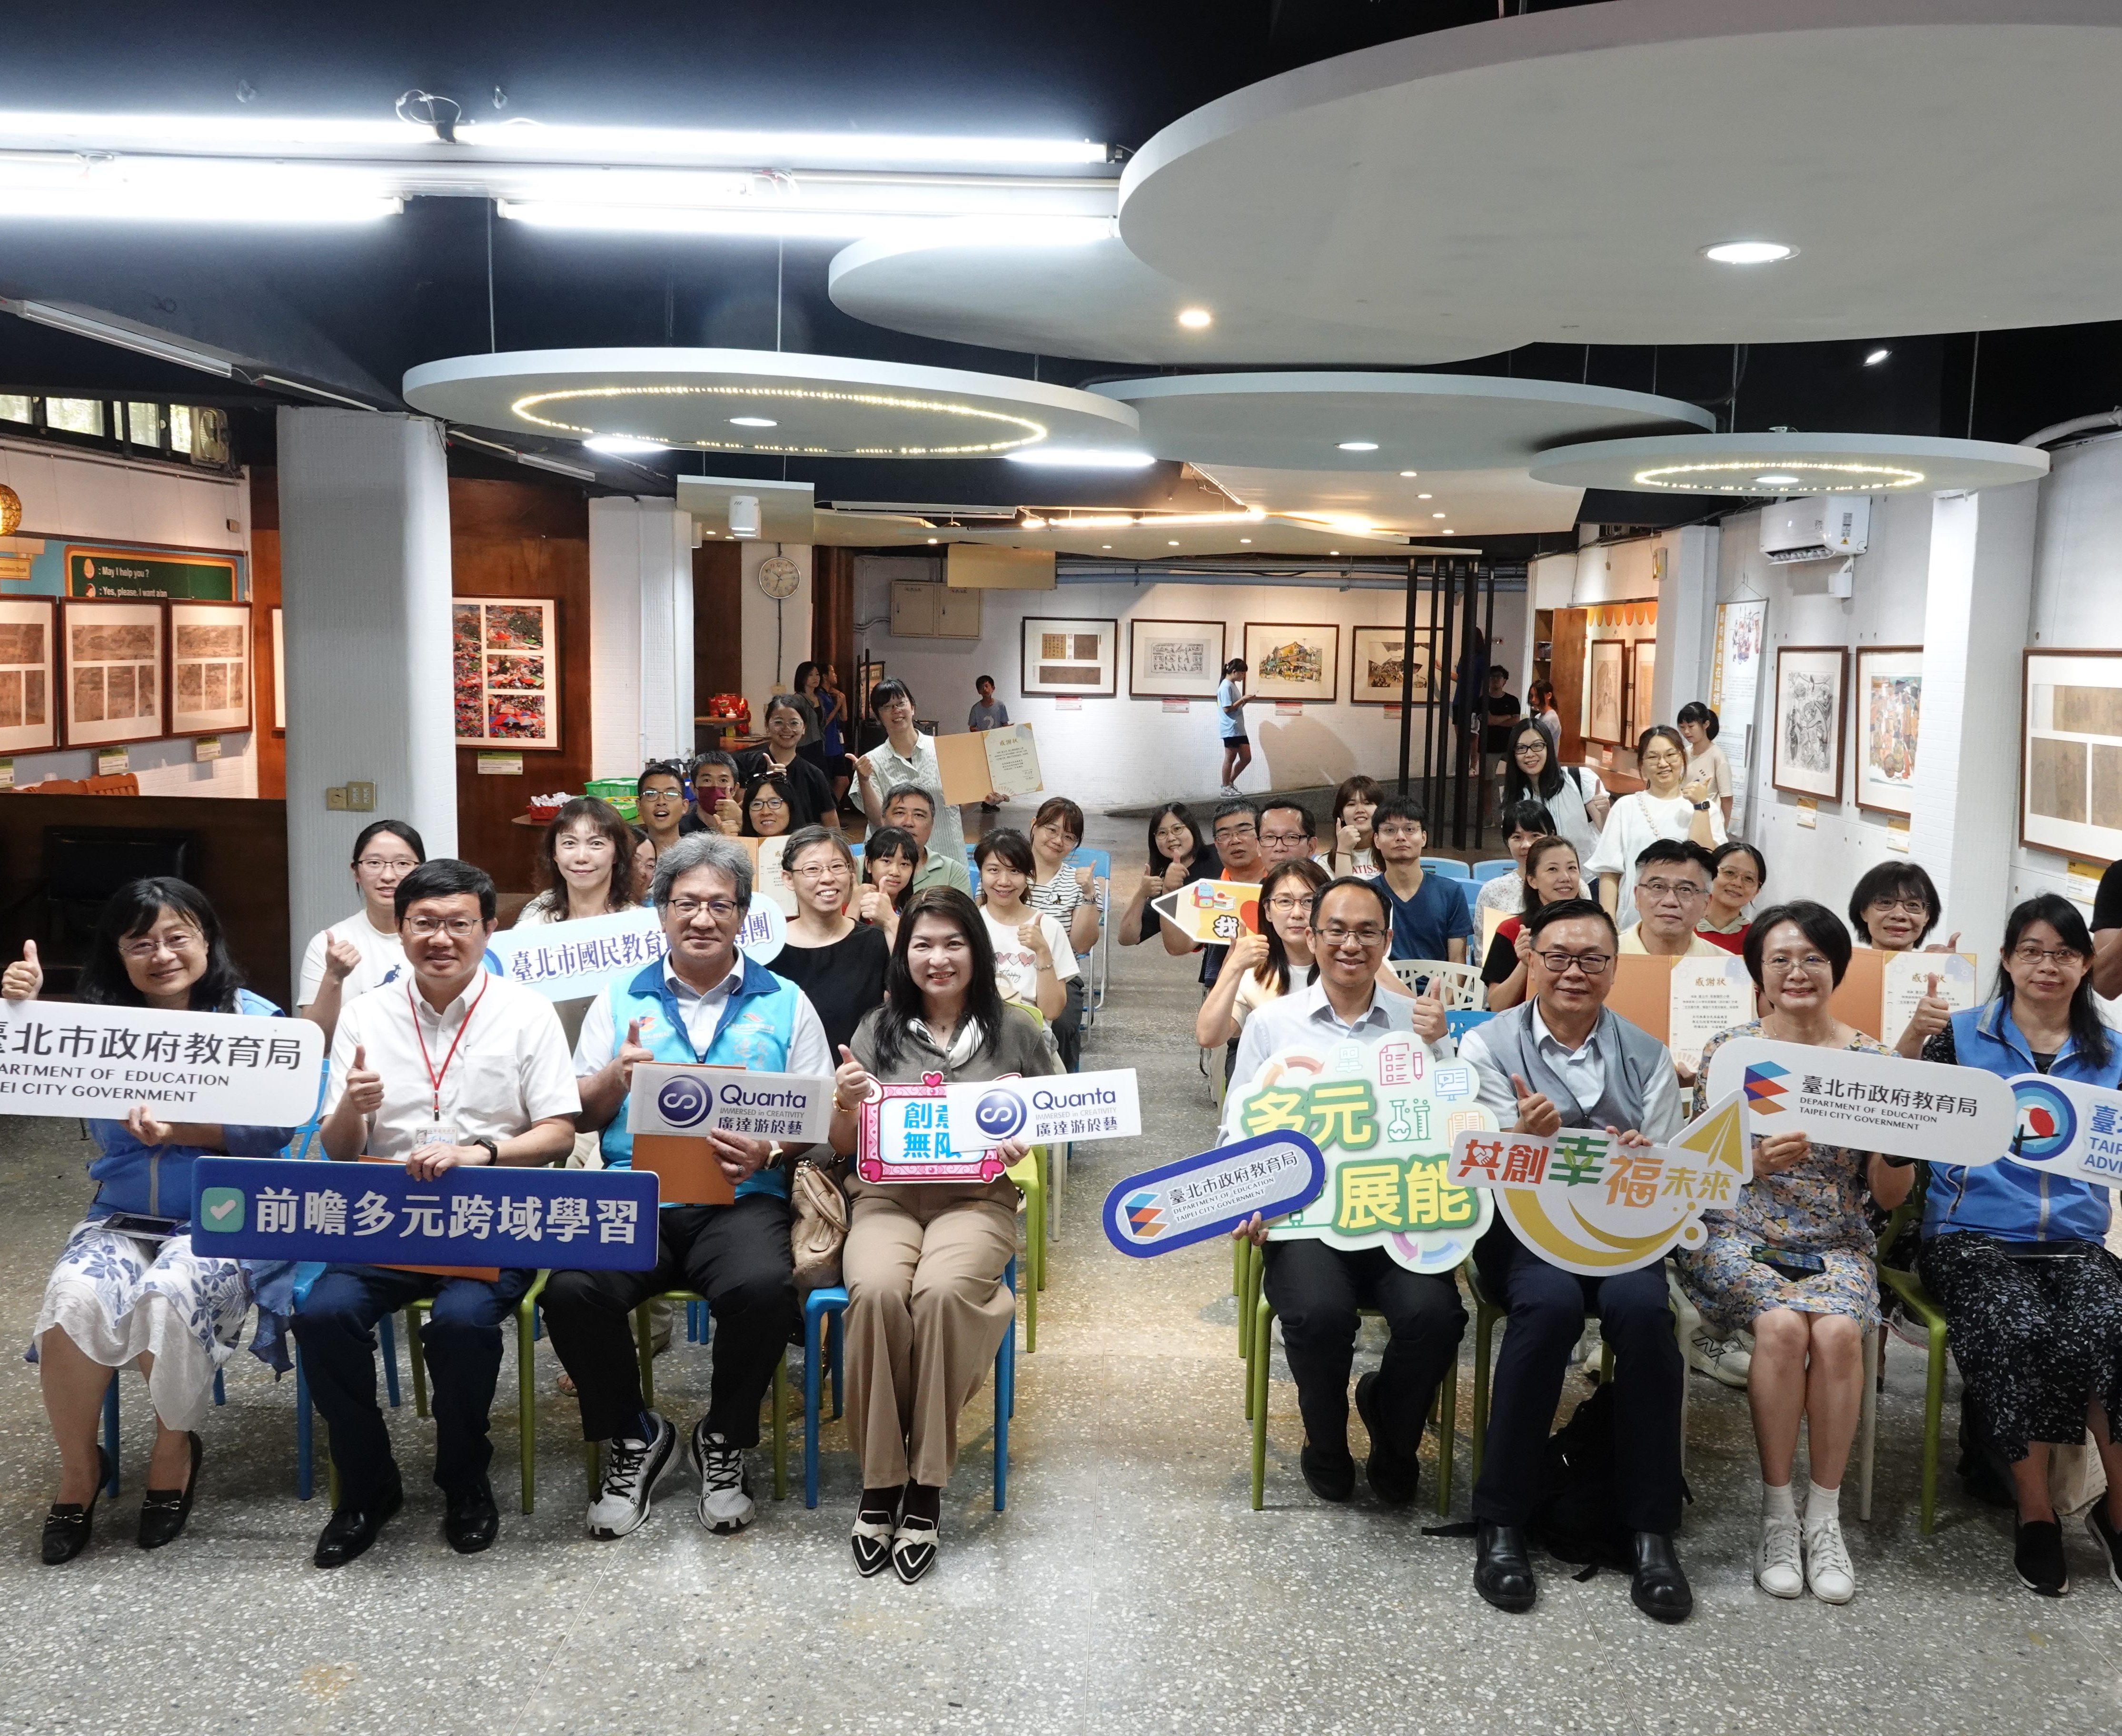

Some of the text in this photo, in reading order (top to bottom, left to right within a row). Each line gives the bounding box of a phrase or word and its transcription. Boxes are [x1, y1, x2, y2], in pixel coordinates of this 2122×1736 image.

[102, 566, 115, 578] May
[120, 567, 133, 578] help
[134, 570, 144, 579] you
[102, 586, 116, 597] Yes,
[1352, 865, 1379, 874] ATISS
[1696, 977, 1726, 986] 感謝狀
[0, 1022, 301, 1070] 北市政府教育局
[91, 1068, 115, 1080] OF
[125, 1070, 230, 1086] EDUCATION
[22, 1083, 67, 1095] CITY
[72, 1085, 198, 1103] GOVERNMENT
[720, 1084, 806, 1108] Quanta
[1032, 1087, 1116, 1110] Quanta
[1801, 1075, 1977, 1117] 臺北市政府教育局
[720, 1107, 756, 1115] IMMERSED
[766, 1110, 804, 1118] CREATIVITY
[1035, 1112, 1070, 1120] IMMERSED
[1080, 1107, 1117, 1116] CREATIVITY
[1248, 1085, 1372, 1144] 多元
[1799, 1107, 1920, 1130] TAIPEI CITY GOVERNMENT
[1800, 1097, 1861, 1112] DEPARTMENT
[1881, 1109, 1937, 1123] EDUCATION
[2090, 1105, 2122, 1135] 臺
[718, 1116, 803, 1135] 廣達游於藝
[1036, 1116, 1118, 1137] 廣達游於藝
[1170, 1151, 1298, 1205] 臺北市政府教育局
[1457, 1135, 1734, 1208] 共創幸福未來
[1173, 1177, 1275, 1214] DEPARTMENT OF EDUCATION
[1176, 1189, 1265, 1222] TAIPEI CITY GOVERNMENT
[1338, 1160, 1472, 1229] 展能
[256, 1186, 638, 1244] 前瞻多元跨域學習
